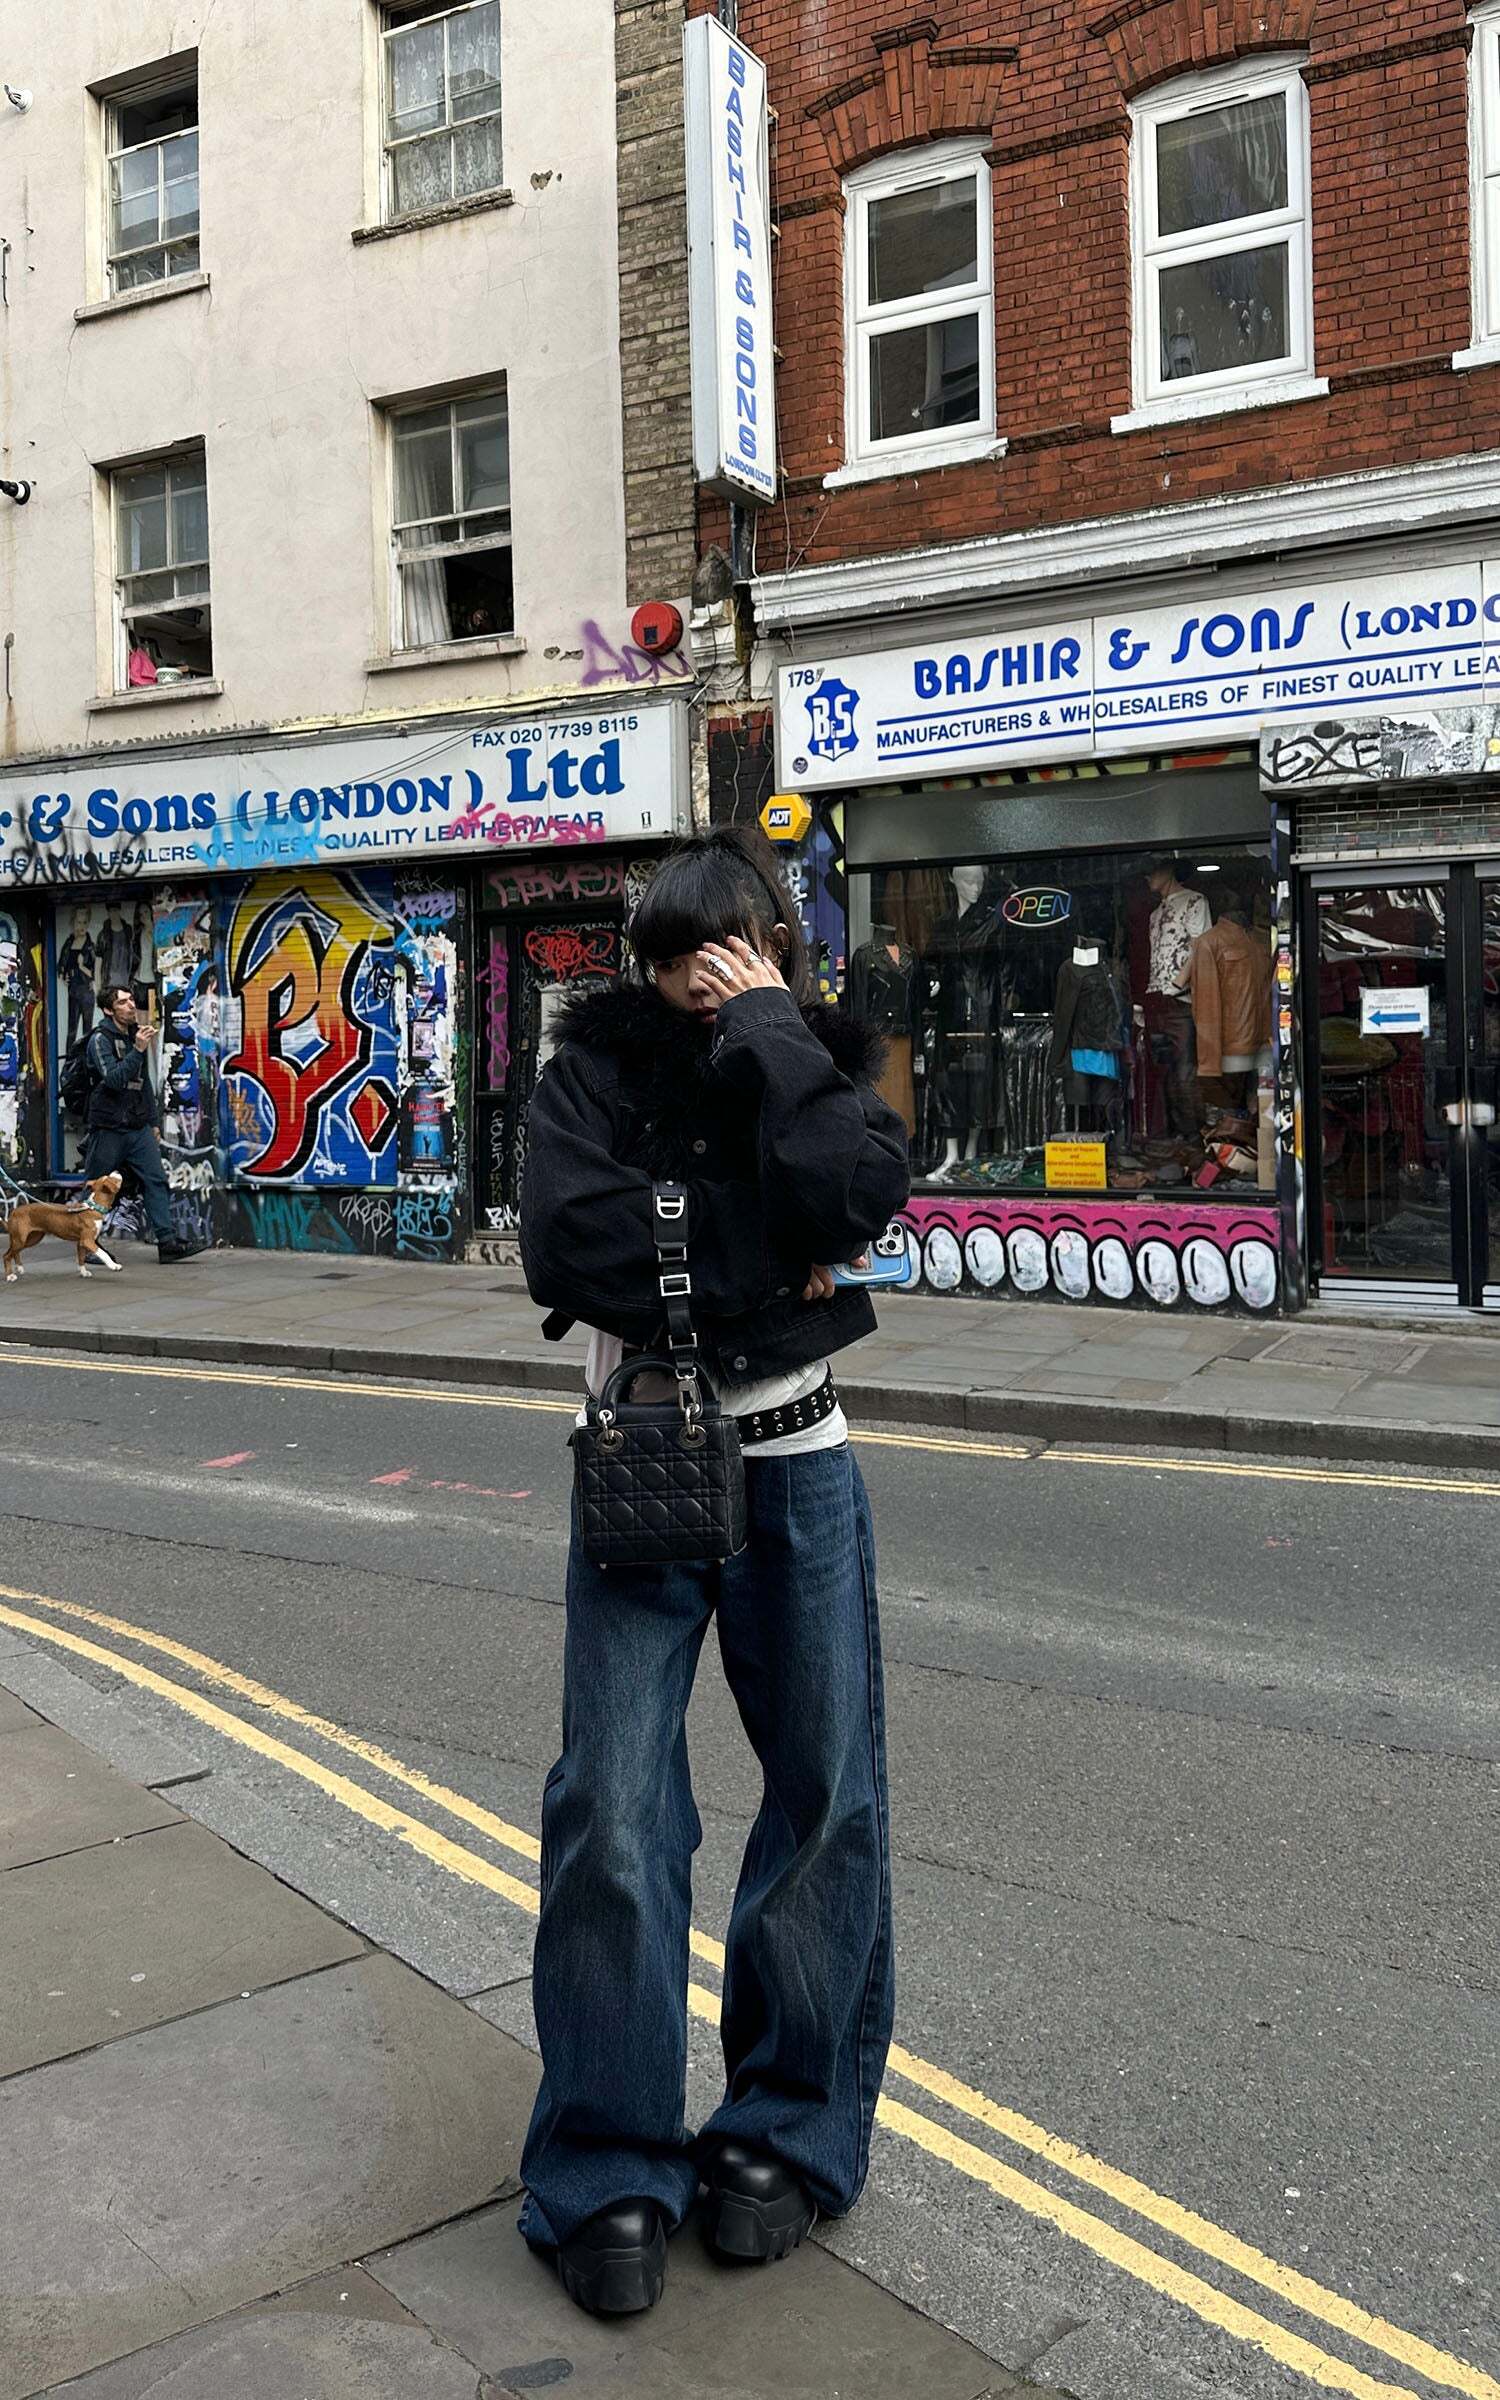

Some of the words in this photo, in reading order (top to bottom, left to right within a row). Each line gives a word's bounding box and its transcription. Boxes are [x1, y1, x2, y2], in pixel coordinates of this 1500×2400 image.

[726, 45, 752, 259] BASHIR
[735, 269, 756, 308] &
[736, 316, 757, 460] SONS
[914, 637, 1081, 699] BASHIR
[1108, 628, 1150, 671] &
[1171, 602, 1314, 664] SONS
[472, 732, 505, 748] FAX
[510, 726, 542, 744] 020
[548, 720, 592, 740] 7739
[598, 716, 639, 734] 8115
[877, 711, 1032, 749] MANUFACTURERS
[1038, 710, 1052, 727] &
[1060, 690, 1208, 724] WHOLESALERS
[1221, 685, 1249, 704] OF
[1263, 674, 1339, 700] FINEST
[1348, 661, 1443, 689] QUALITY
[1453, 655, 1500, 677] LEA
[28, 793, 71, 843] &
[87, 788, 216, 838] Sons
[506, 738, 625, 804] Ltd
[769, 810, 792, 825] ADT
[325, 826, 417, 852] QUALITY
[1002, 895, 1072, 919] OPEN
